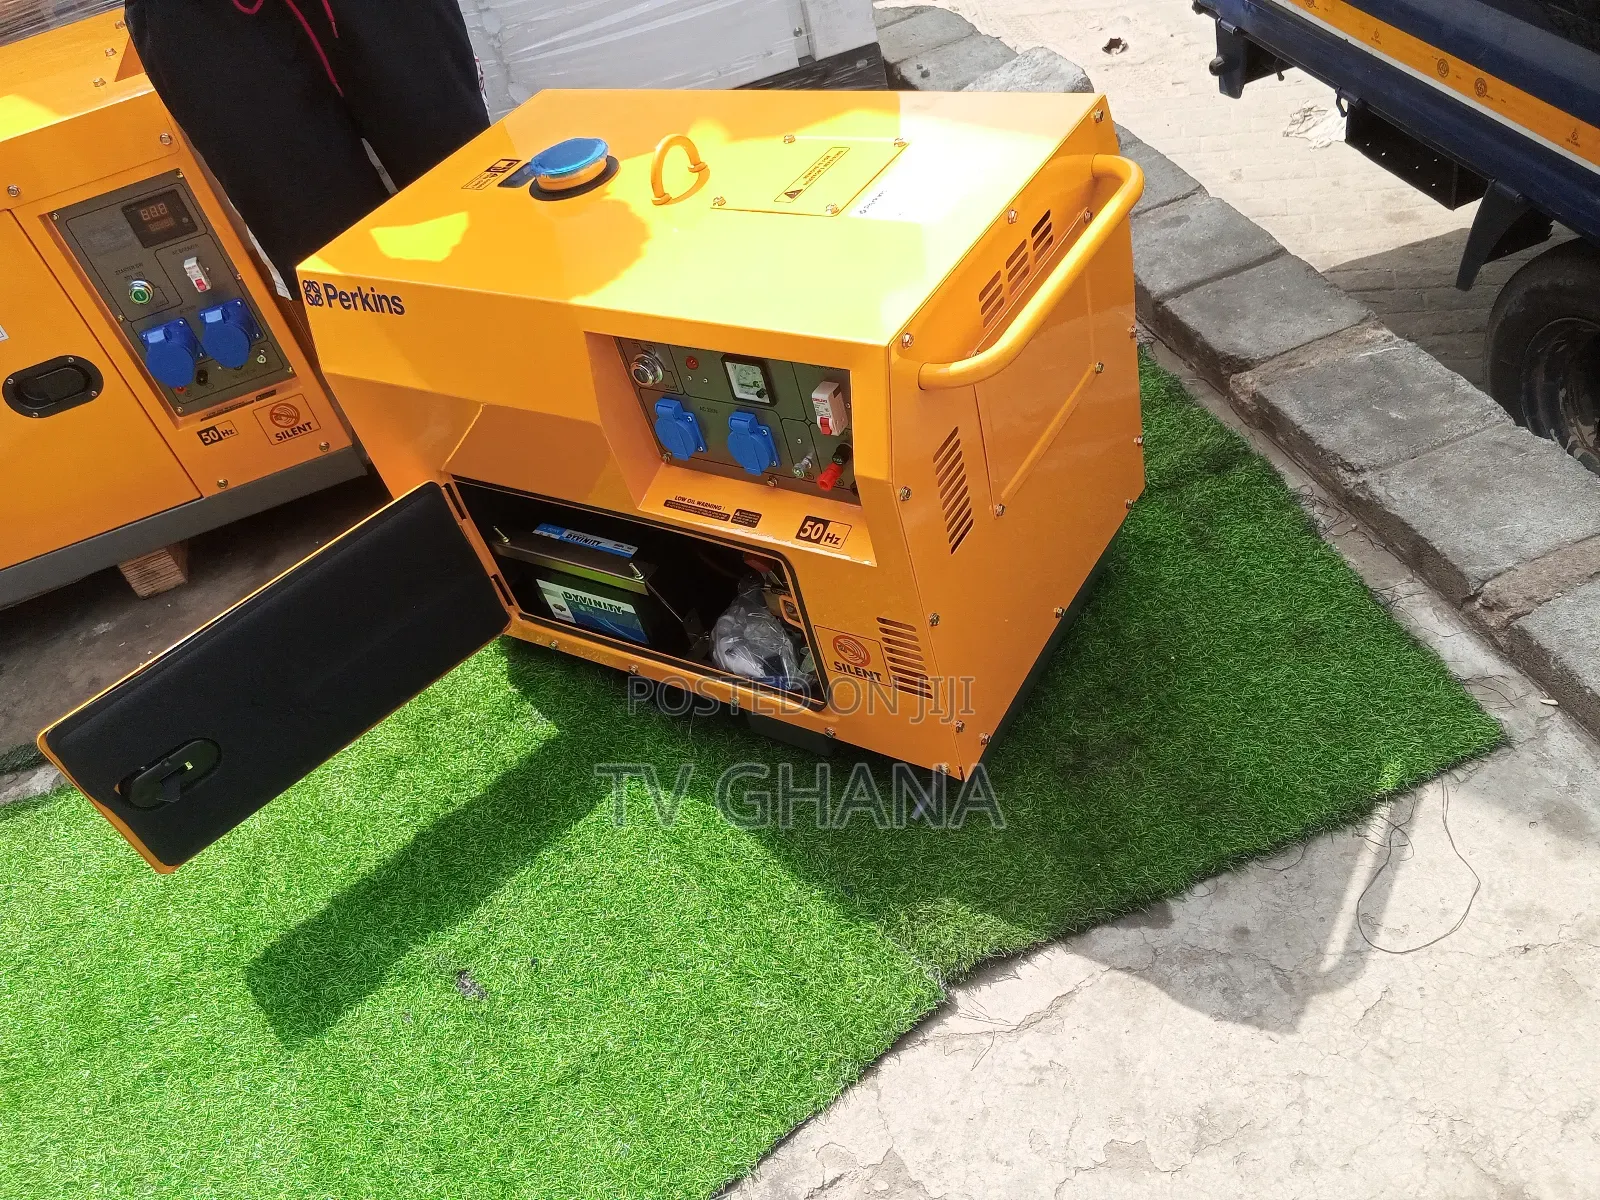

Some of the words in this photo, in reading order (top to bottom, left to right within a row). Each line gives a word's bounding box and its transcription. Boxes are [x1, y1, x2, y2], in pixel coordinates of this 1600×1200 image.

[323, 283, 406, 316] Perkins
[201, 429, 220, 444] 50
[221, 428, 235, 440] Hz
[275, 421, 314, 442] SILENT
[674, 495, 687, 504] LOW
[687, 498, 696, 506] OIL
[696, 499, 723, 511] WARNING
[565, 533, 602, 547] DYVINITY
[800, 520, 823, 540] 50
[824, 532, 842, 546] Hz
[561, 590, 624, 615] DYVINITY
[834, 661, 882, 682] SILENT
